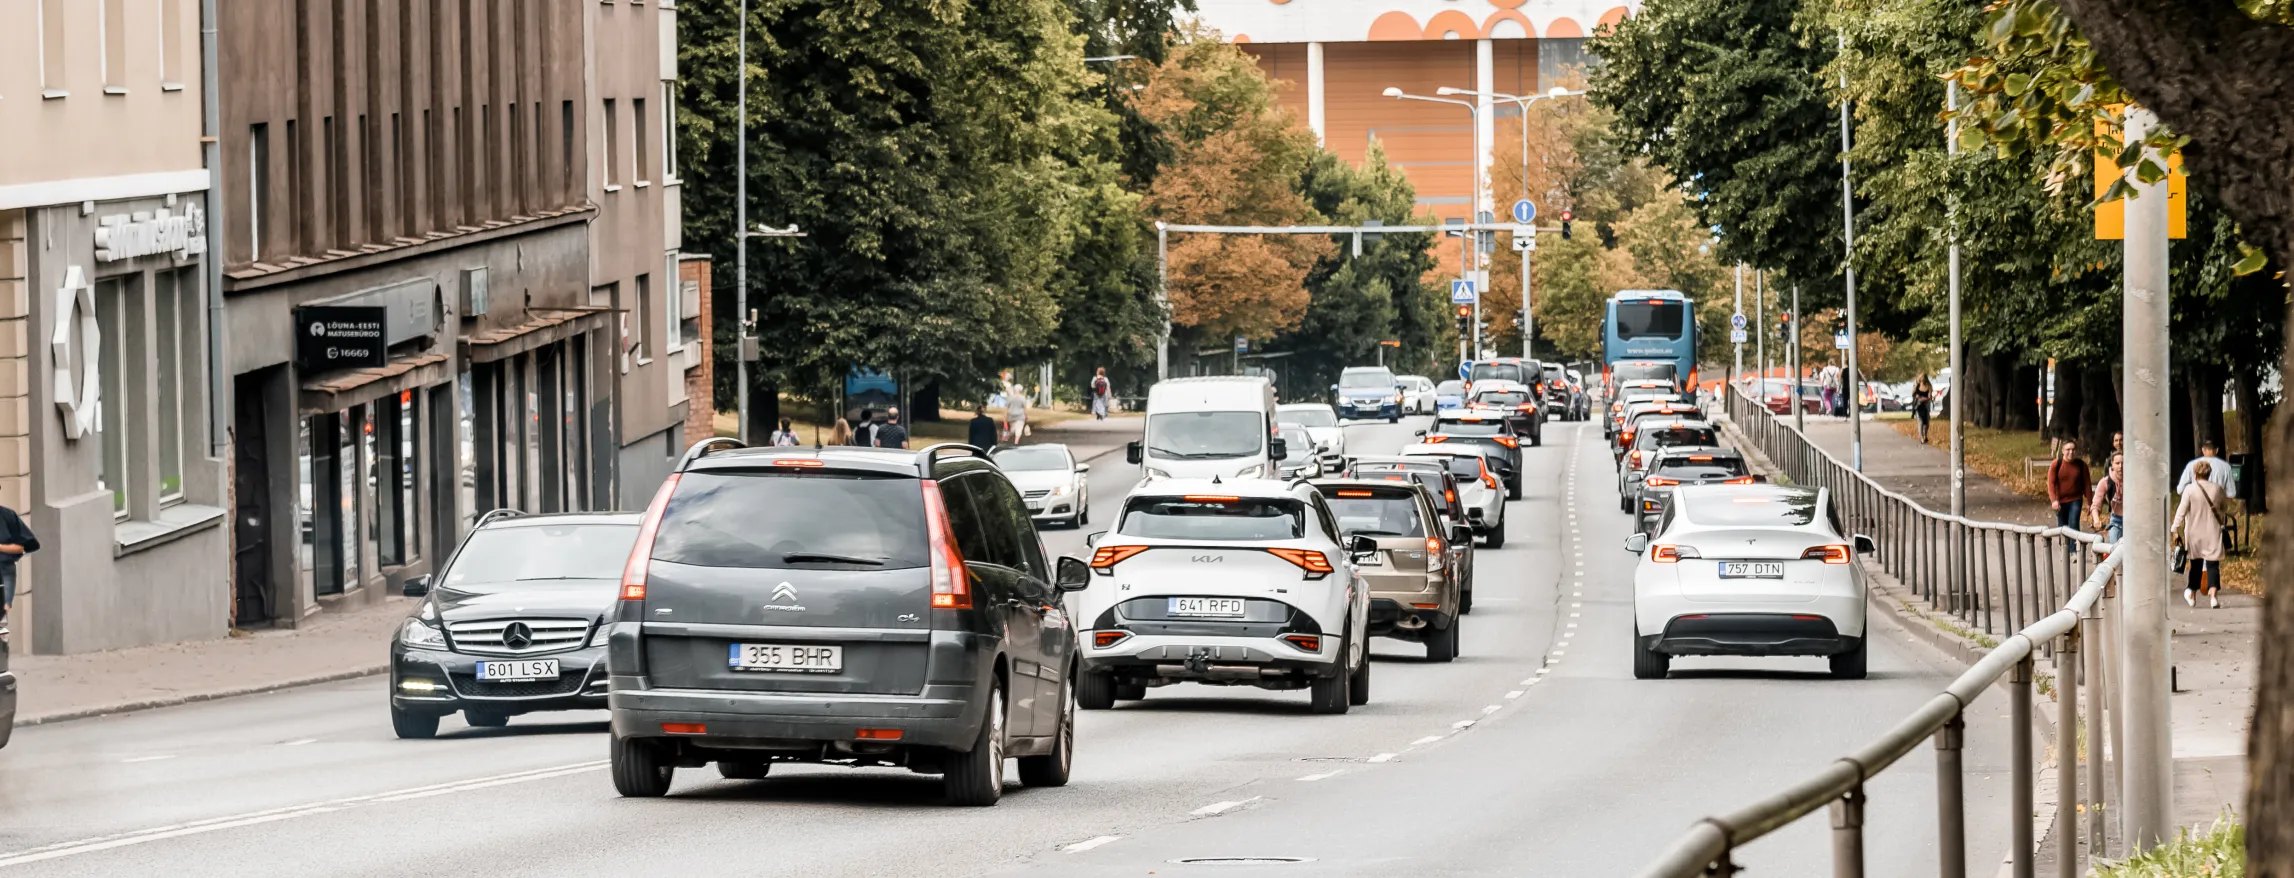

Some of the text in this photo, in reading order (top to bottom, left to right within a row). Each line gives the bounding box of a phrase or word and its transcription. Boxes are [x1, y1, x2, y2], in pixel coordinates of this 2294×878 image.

[327, 321, 380, 330] LÕUNA-EESTI
[327, 330, 380, 338] MATUSEBÜROO
[340, 349, 369, 358] 16669
[1191, 555, 1224, 563] KIA
[1728, 563, 1780, 574] 757 DTN
[1179, 599, 1241, 612] 641 RFD
[749, 646, 834, 667] 355 BHR
[488, 661, 554, 677] 601 LSX
